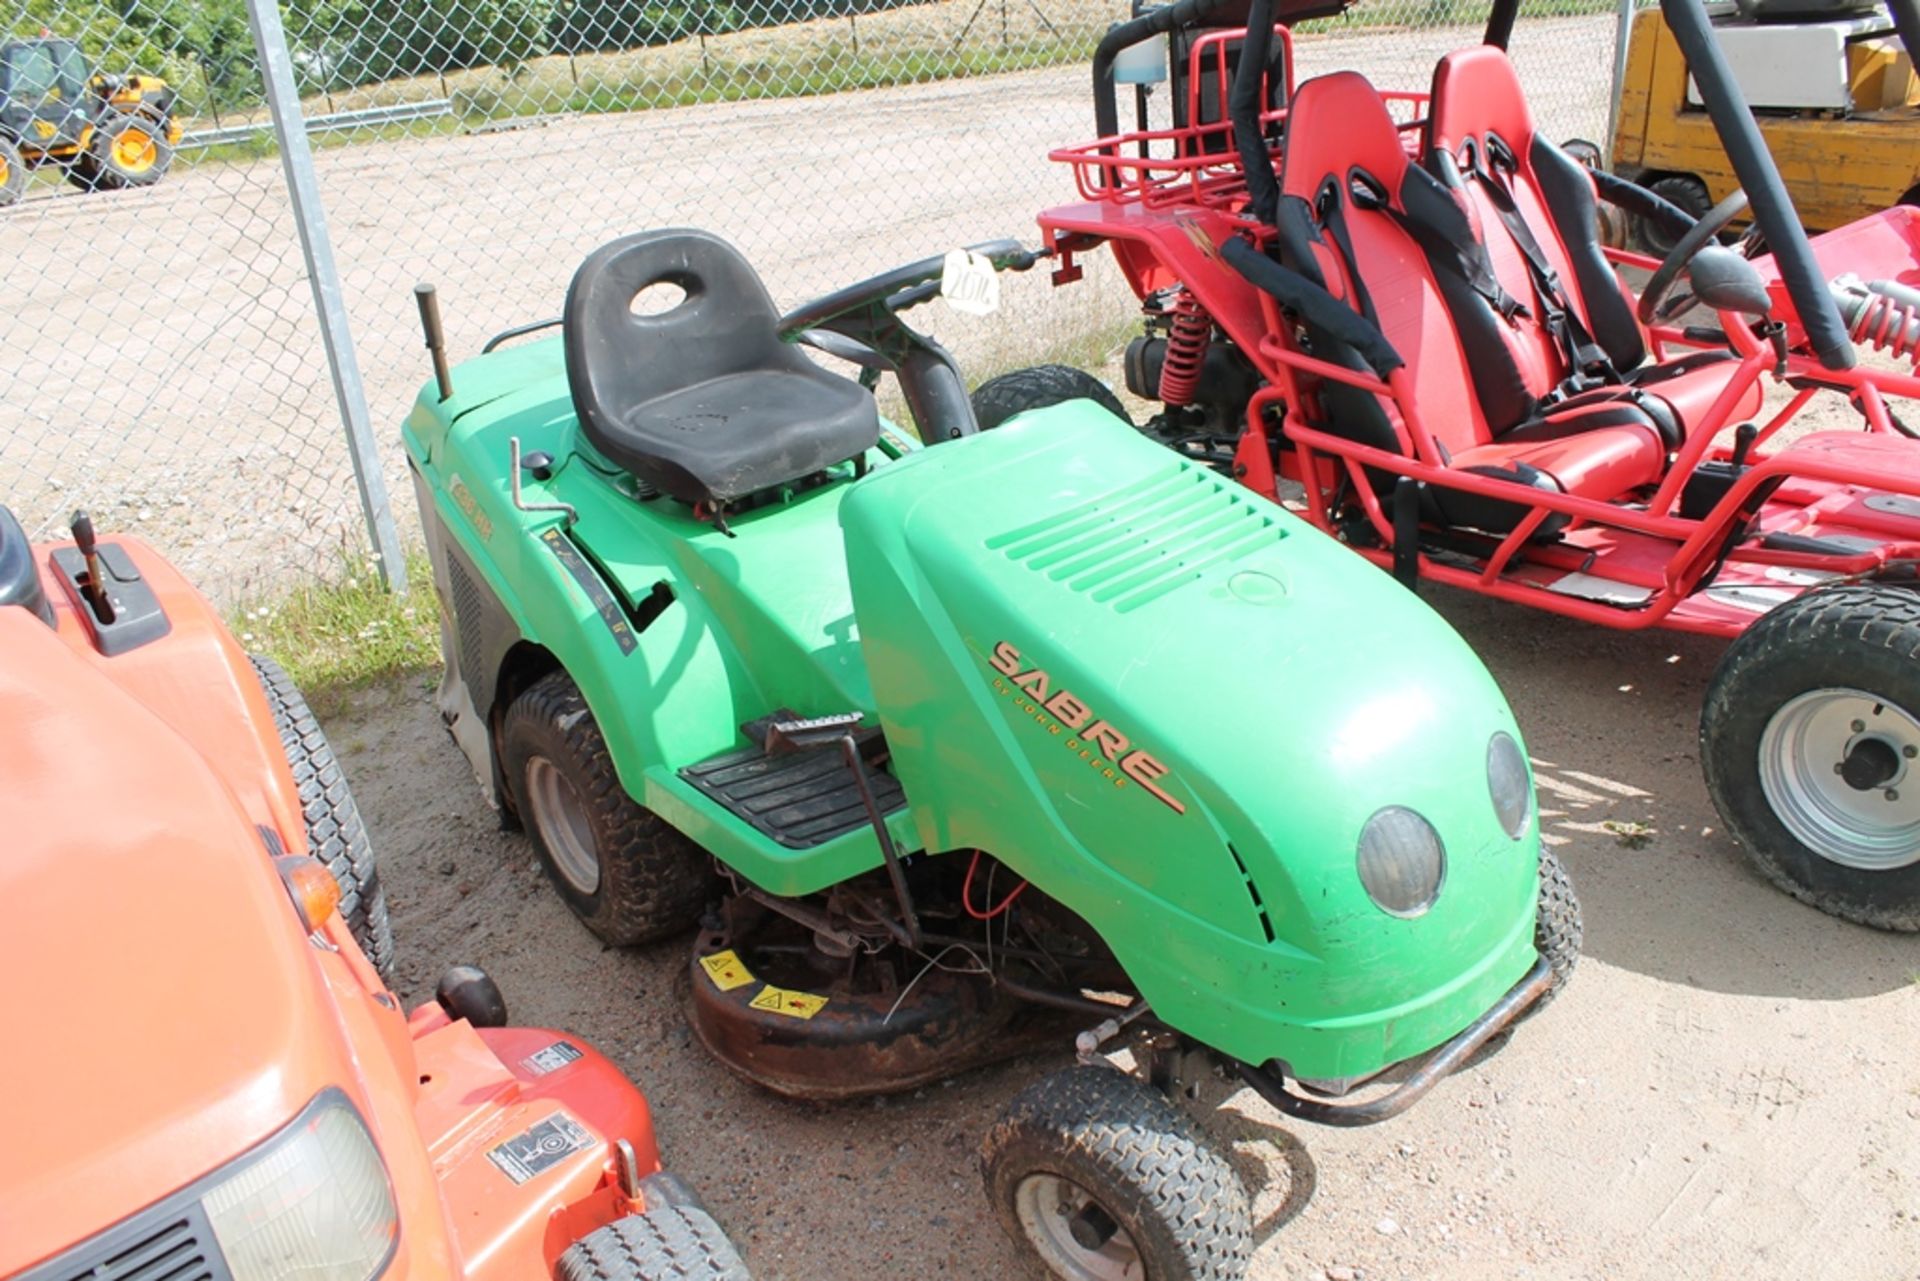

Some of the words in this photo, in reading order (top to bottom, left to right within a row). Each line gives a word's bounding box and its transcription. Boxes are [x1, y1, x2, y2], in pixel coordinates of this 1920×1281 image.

[988, 640, 1187, 816] SABRE
[1014, 696, 1062, 735] JOHN
[1066, 737, 1127, 788] DEERE
